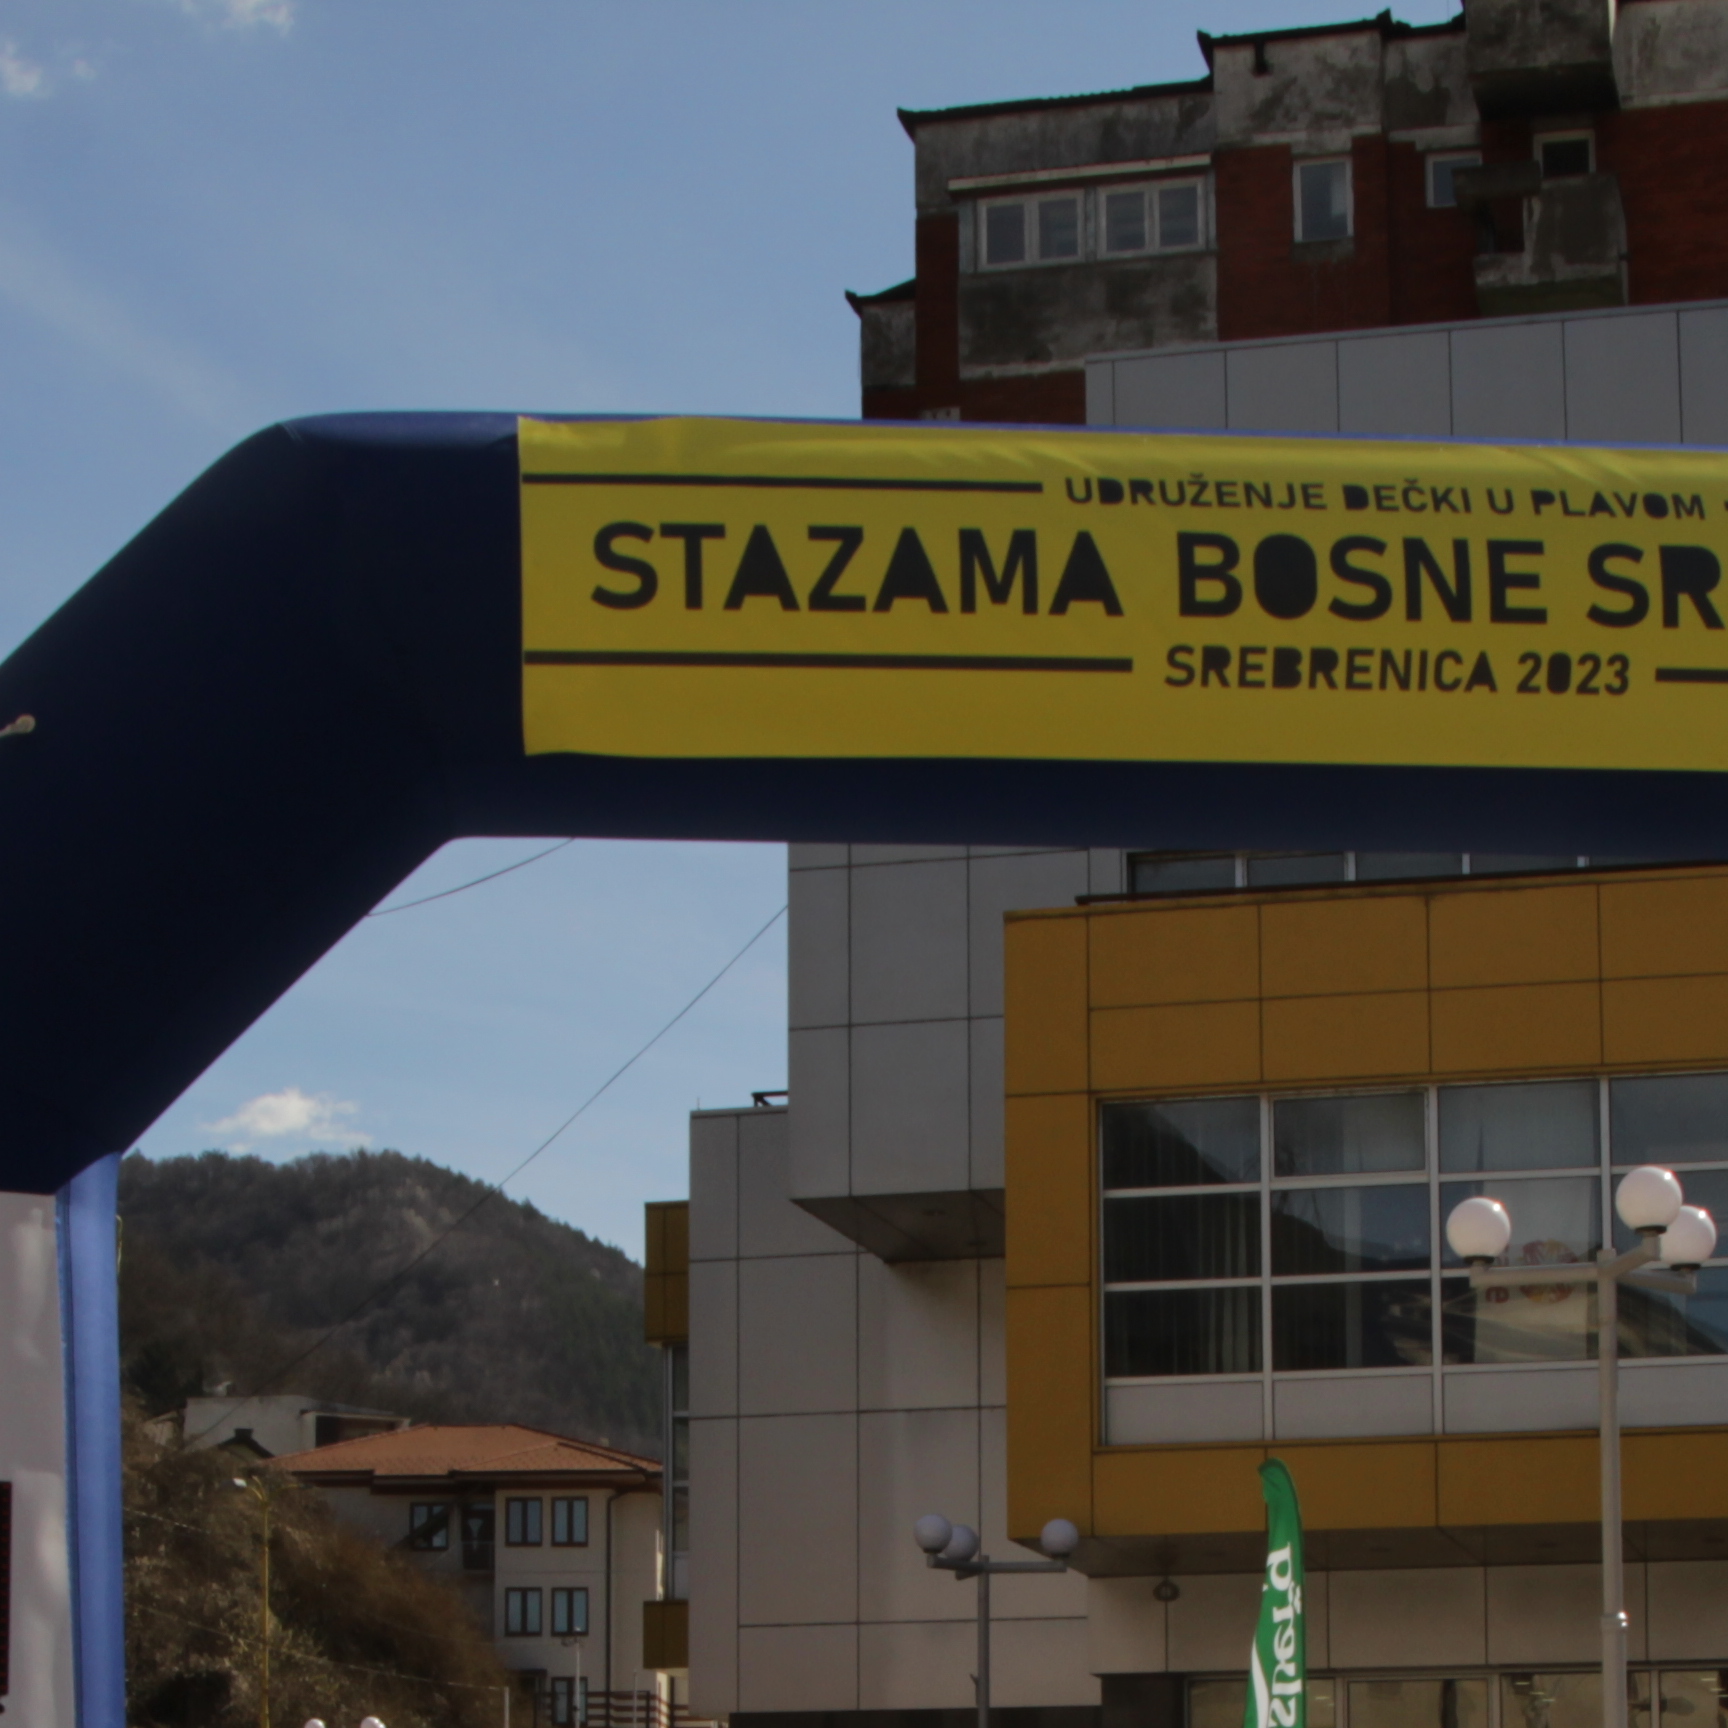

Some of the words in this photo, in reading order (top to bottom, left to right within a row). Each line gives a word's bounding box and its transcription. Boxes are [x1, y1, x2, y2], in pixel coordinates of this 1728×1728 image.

[1065, 473, 1327, 509] UDRUŽENJE
[1342, 478, 1472, 514] DEČKI
[1486, 487, 1515, 515] U
[1530, 487, 1706, 520] PLAVOM
[590, 521, 1124, 617] STAZAMA
[1176, 530, 1548, 624] BOSNE
[1164, 644, 1498, 693] SREBRENICA
[1515, 652, 1630, 696] 2023
